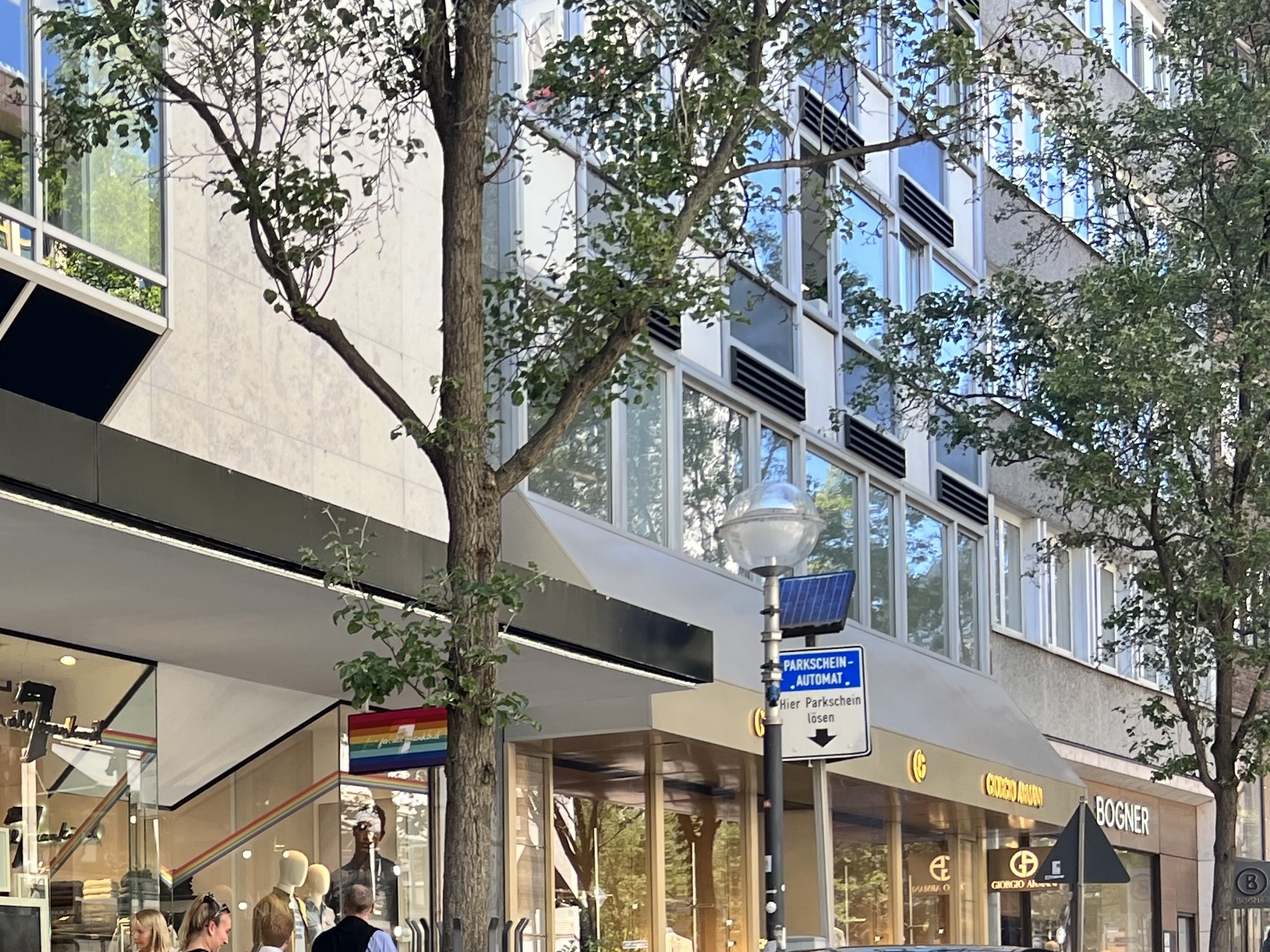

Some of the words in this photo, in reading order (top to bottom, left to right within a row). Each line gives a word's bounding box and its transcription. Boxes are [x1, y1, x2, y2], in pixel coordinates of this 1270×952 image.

[783, 656, 854, 672] PARKSCHEIN-
[796, 672, 843, 687] AUTOMAT
[779, 698, 801, 710] Hier
[805, 694, 861, 708] Parkschein
[807, 712, 835, 724] lösen
[1095, 795, 1150, 836] BOGNER
[991, 880, 1025, 889] GIORGIO
